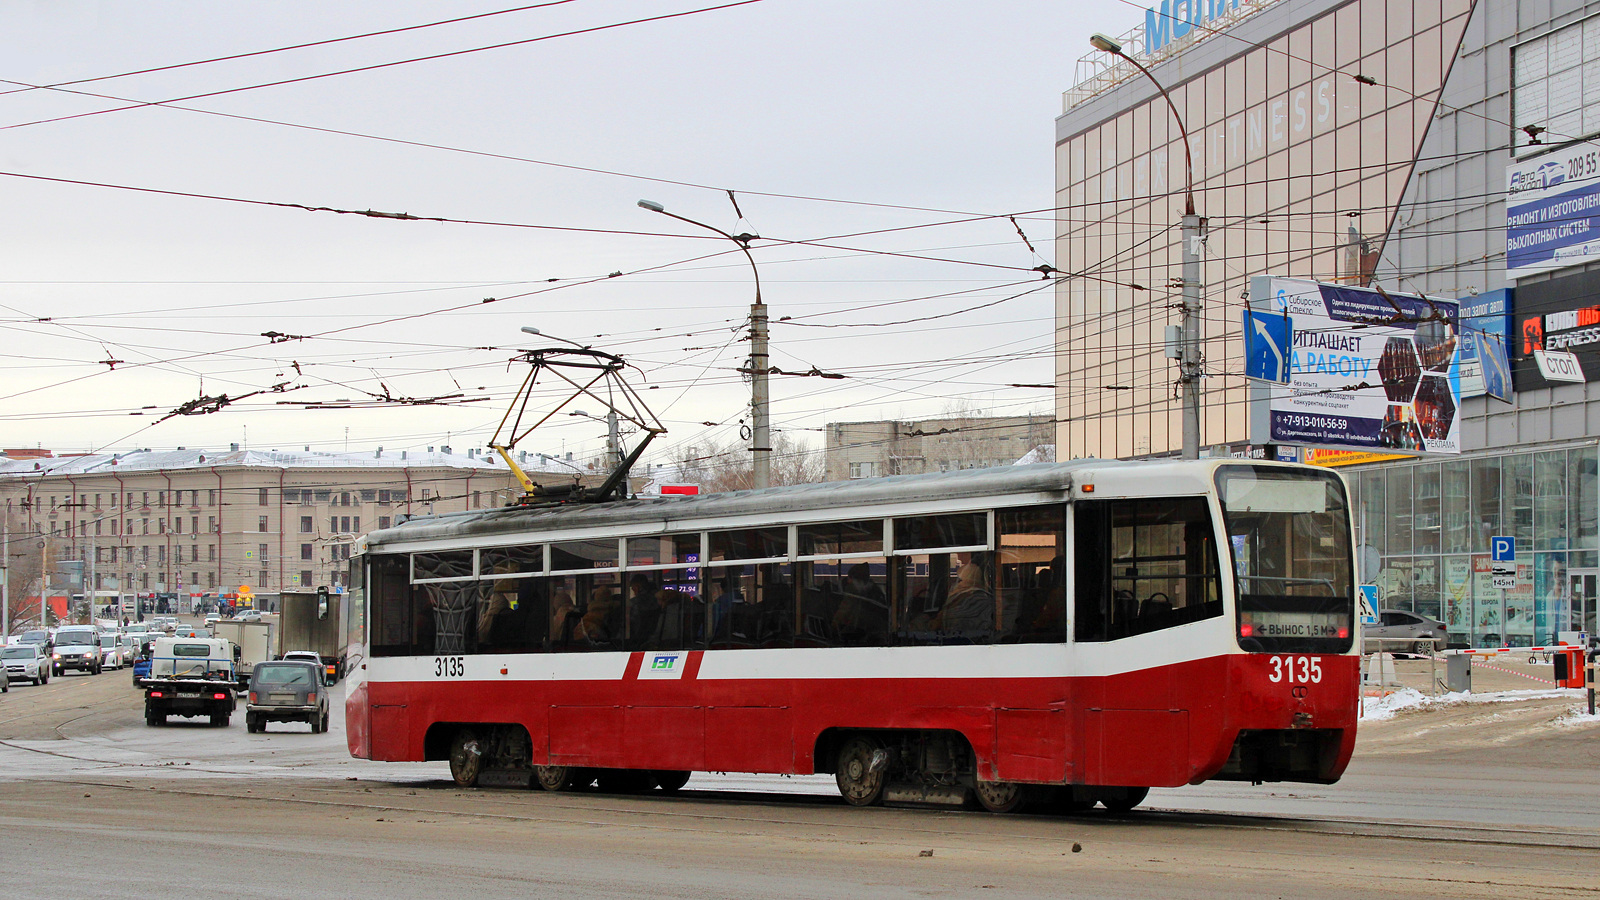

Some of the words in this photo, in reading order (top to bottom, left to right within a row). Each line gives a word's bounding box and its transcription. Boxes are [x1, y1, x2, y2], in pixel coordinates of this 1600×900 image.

[1188, 80, 1331, 176] FITNESS
[1568, 156, 1583, 179] 209
[1586, 152, 1597, 174] 55
[1507, 210, 1539, 230] РЕМОНТ
[1540, 207, 1547, 222] И
[1507, 227, 1558, 251] ВЫХЛОПНЫХ
[1558, 218, 1590, 239] СИСТЕМ
[1471, 303, 1489, 318] залог
[1489, 300, 1504, 314] авто
[1546, 327, 1600, 351] EXPRESS
[1307, 352, 1371, 379] РАБОТУ
[1546, 357, 1577, 376] СТОП
[1283, 415, 1348, 430] +7-913-010-56-59
[1426, 440, 1456, 449] РЕКЛАМА
[1496, 540, 1510, 560] P
[1268, 624, 1304, 635] ВЫНОС
[1306, 625, 1319, 637] 1,5
[434, 656, 464, 677] 3135
[1268, 655, 1322, 683] 3135
